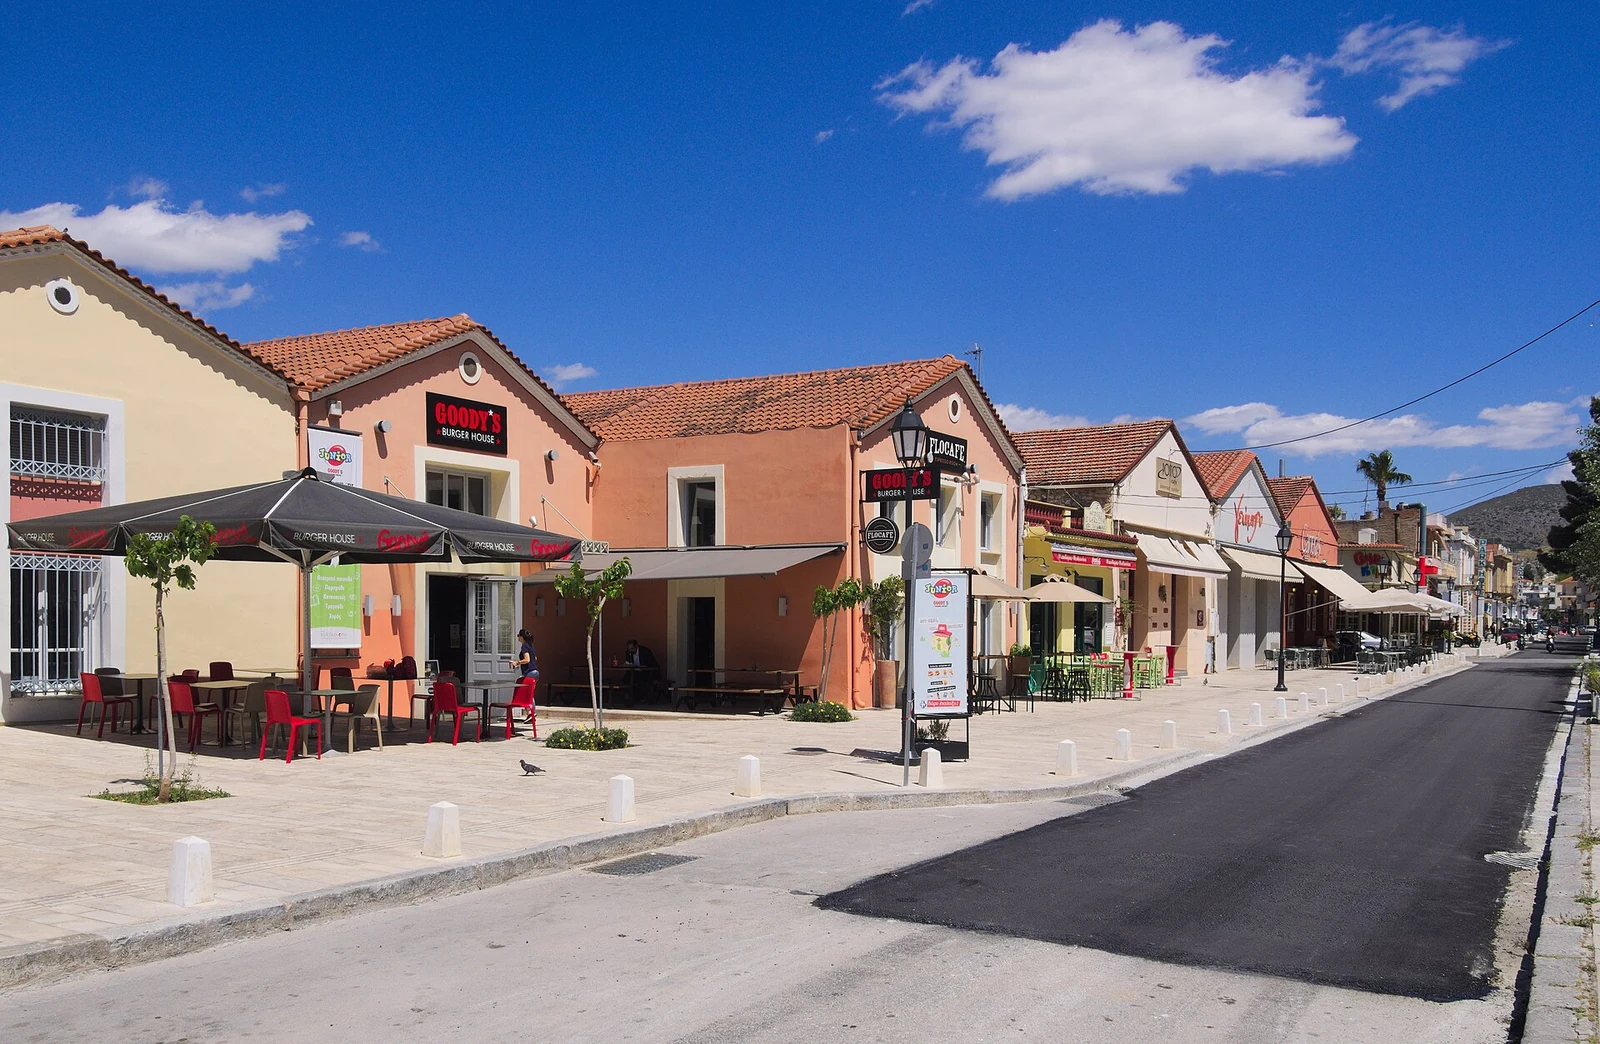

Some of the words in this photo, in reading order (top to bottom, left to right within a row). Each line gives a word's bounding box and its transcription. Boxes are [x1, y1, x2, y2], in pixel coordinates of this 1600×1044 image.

[435, 402, 501, 433] GOODY'S
[441, 427, 470, 439] BURGER
[471, 432, 495, 443] HOUSE
[877, 489, 901, 497] BURGER
[293, 532, 327, 543] BURGER
[329, 533, 355, 544] HOUSE
[867, 531, 894, 540] FLOCAFE
[466, 541, 494, 551] BURGER
[494, 543, 515, 552] HOUSE
